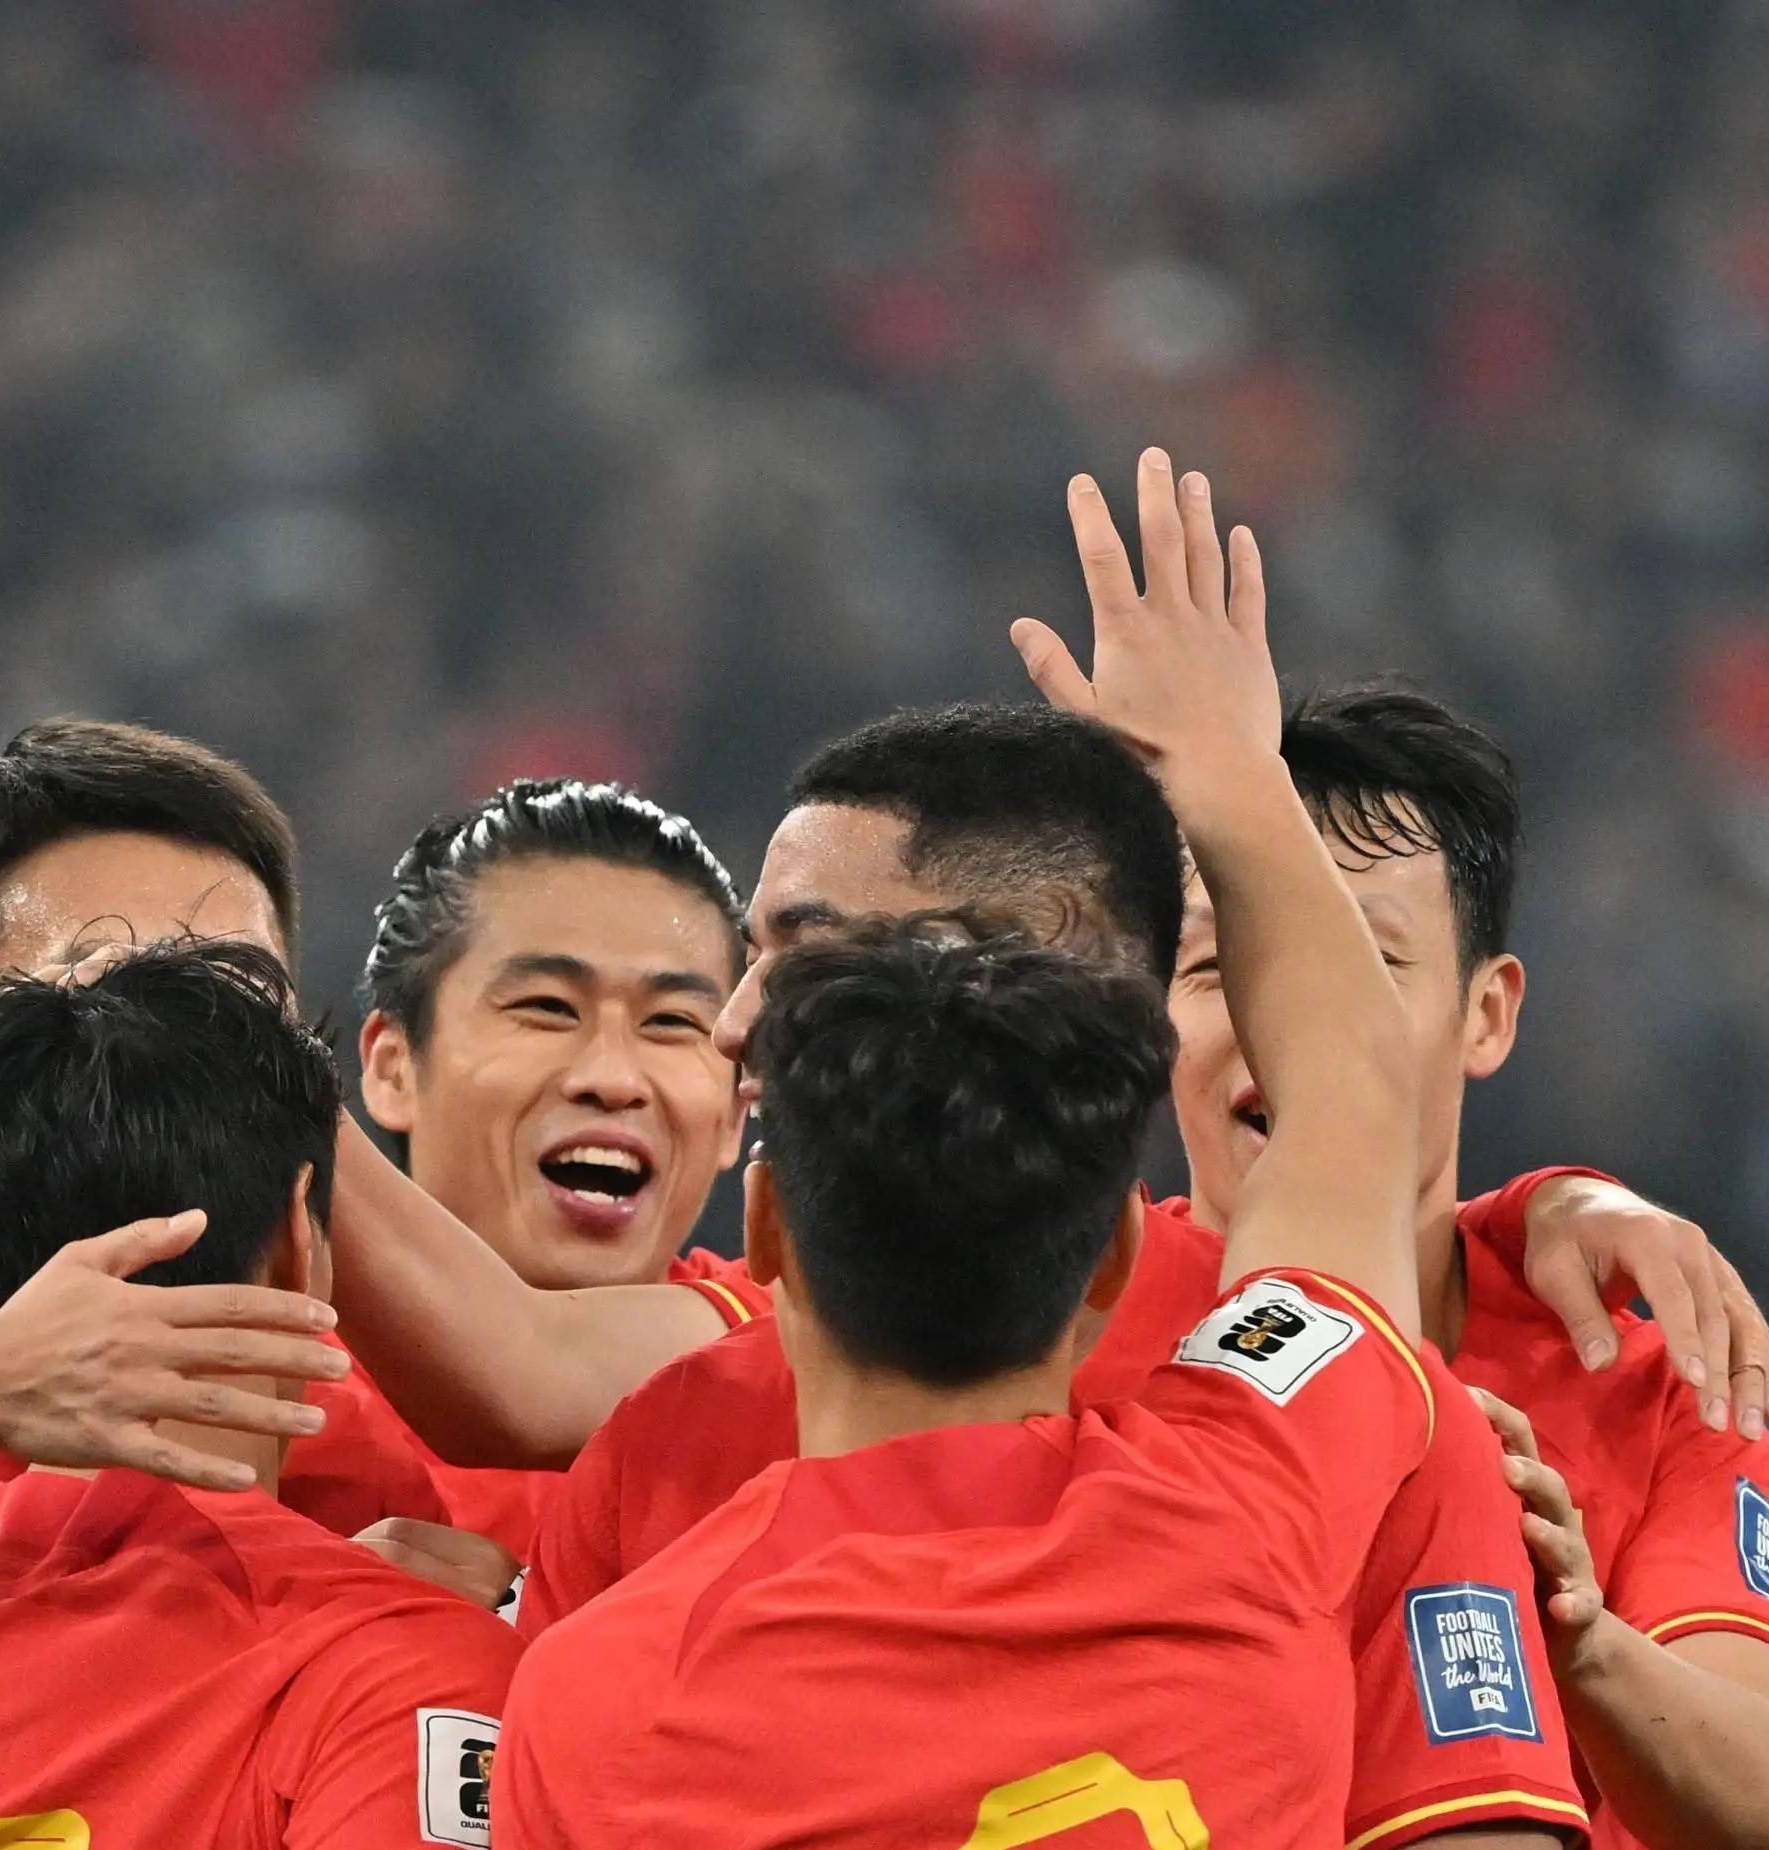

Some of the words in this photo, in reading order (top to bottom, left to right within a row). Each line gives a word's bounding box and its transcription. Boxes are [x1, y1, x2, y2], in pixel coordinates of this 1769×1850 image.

[1436, 1609, 1501, 1634] FOOTBALL
[1440, 1630, 1506, 1663] UNITES
[1441, 1664, 1476, 1690] the
